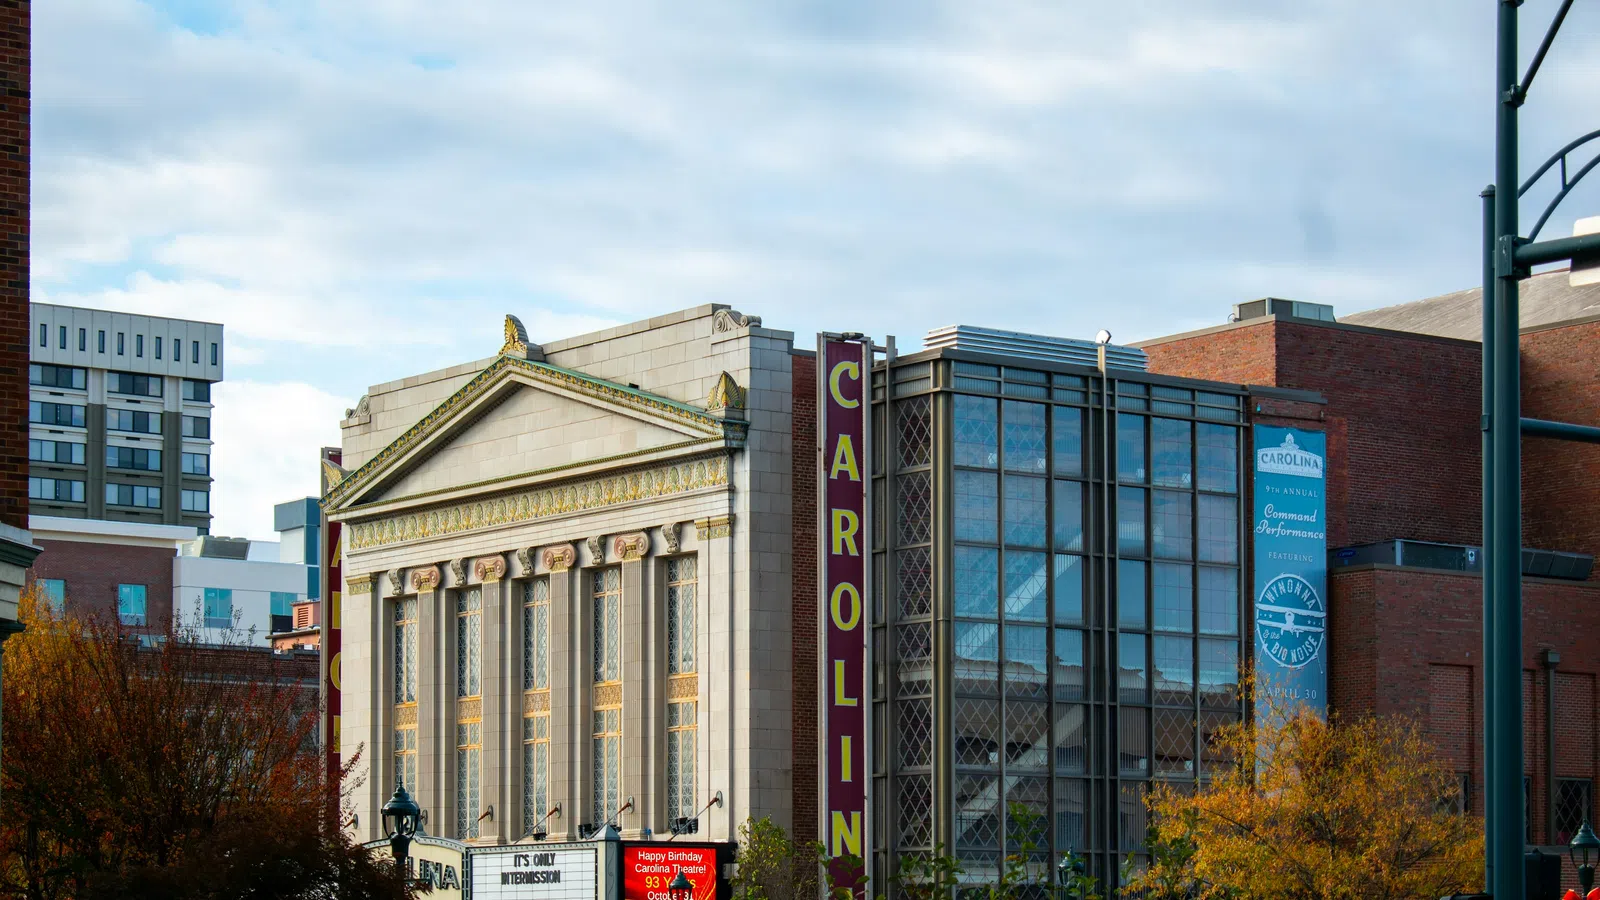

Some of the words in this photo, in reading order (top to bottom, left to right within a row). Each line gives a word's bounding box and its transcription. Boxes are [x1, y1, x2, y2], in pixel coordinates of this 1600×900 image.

[1261, 452, 1319, 469] CAROLINA
[1265, 485, 1280, 494] 9TH
[1283, 487, 1318, 498] ANNUAL
[1264, 503, 1318, 522] Command
[1256, 519, 1324, 539] Performance
[1268, 551, 1313, 562] FEATURING
[1265, 579, 1316, 609] WYNONNA
[828, 360, 862, 900] CAROLIN
[1262, 629, 1270, 640] &
[1271, 641, 1288, 661] BIG
[1290, 635, 1318, 663] NOISE
[1267, 687, 1300, 700] APRIL
[1305, 689, 1317, 700] 30
[514, 854, 529, 867] IT'S
[533, 853, 556, 867] ONLY
[638, 851, 666, 862] Happy
[668, 852, 703, 863] Birthday
[635, 863, 670, 873] Carolina
[672, 864, 706, 873] Theatre!
[501, 870, 561, 885] INTERMISSION
[645, 876, 660, 888] 93
[647, 891, 682, 900] Octoe
